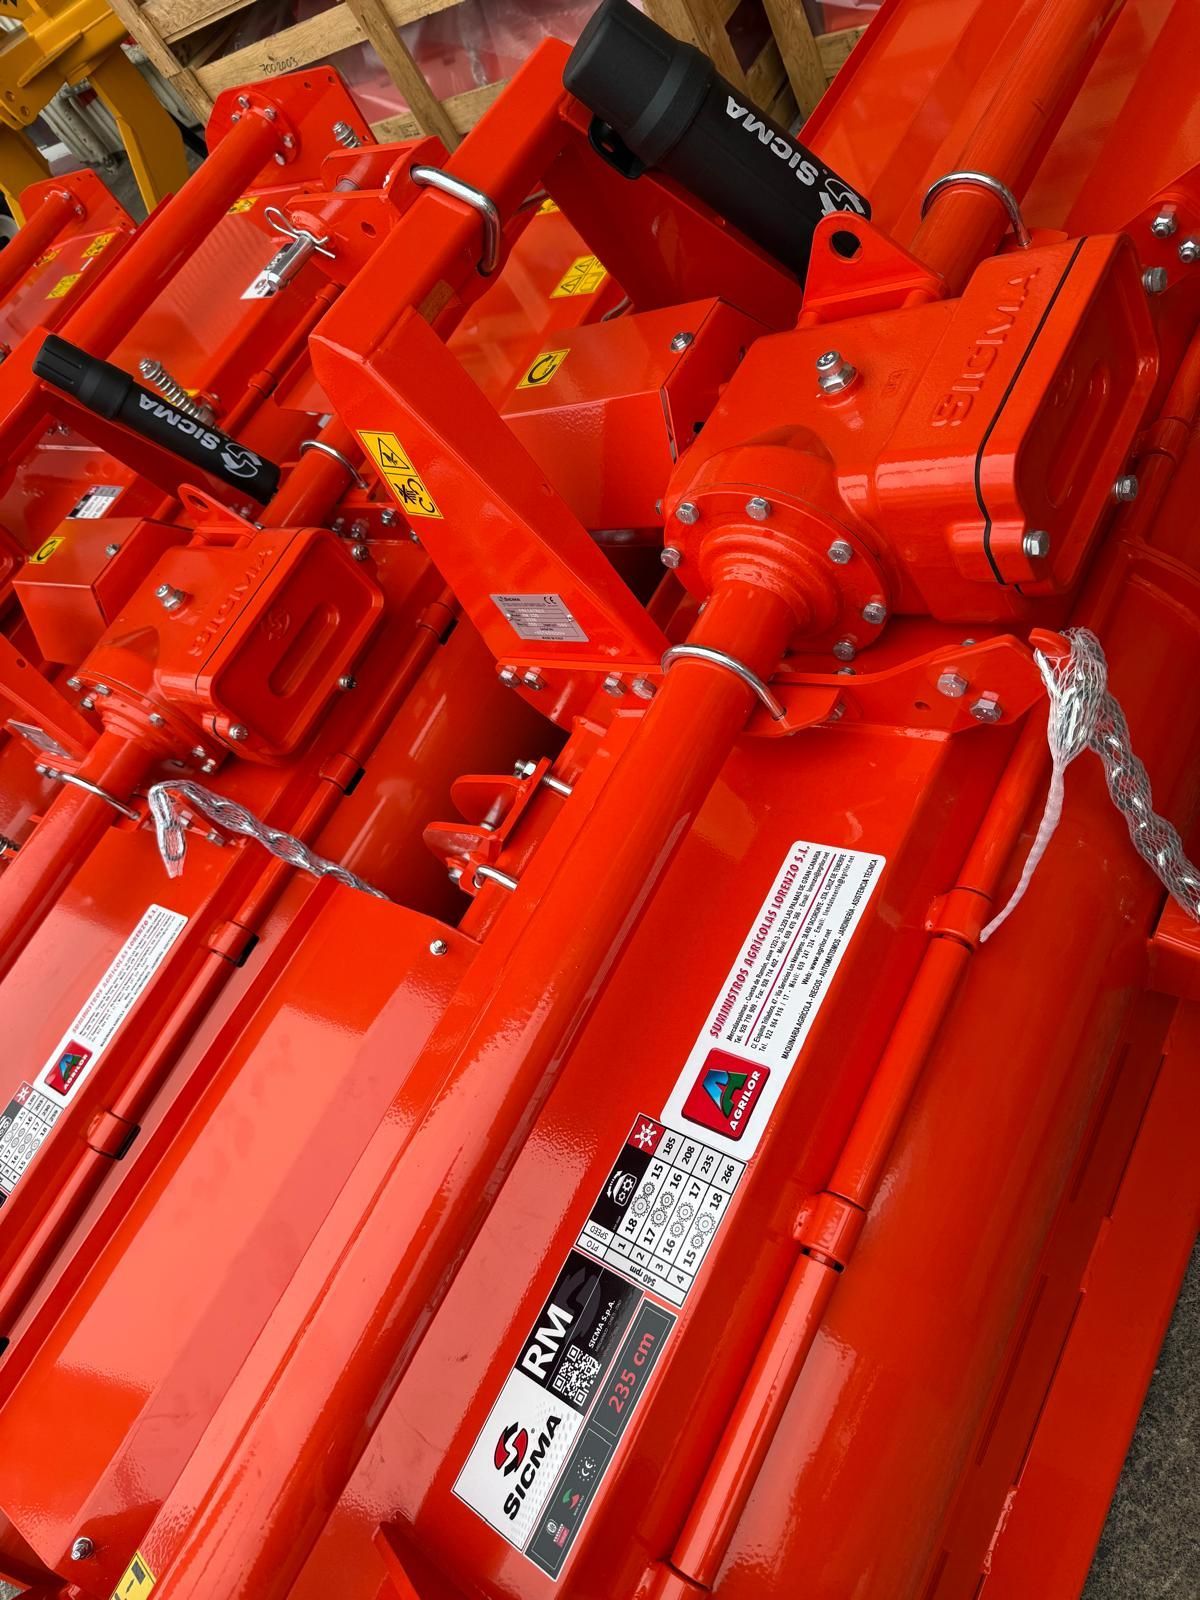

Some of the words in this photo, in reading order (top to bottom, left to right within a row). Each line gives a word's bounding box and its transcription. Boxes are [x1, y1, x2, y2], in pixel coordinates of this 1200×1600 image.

[726, 95, 819, 186] SICMA
[930, 267, 1042, 427] SICMA
[139, 393, 220, 450] SICMA
[800, 869, 812, 884] GRAN
[807, 850, 822, 870] CANARIA
[788, 890, 802, 909] PALMAS
[796, 883, 805, 891] DE
[783, 908, 793, 919] LAS
[709, 968, 748, 1038] SUMINISTROS
[743, 909, 777, 967] AGRÍCOLAS
[771, 863, 799, 909] LORENZO
[793, 845, 810, 863] S.L.
[752, 1024, 766, 1043] Esquina
[777, 970, 791, 989] Servicios
[786, 962, 795, 971] Los
[824, 878, 834, 890] CRUZ
[832, 853, 846, 872] TENERIFE
[780, 1026, 801, 1059] MAQUINARIA
[795, 1000, 813, 1027] AGRÍCOLA
[808, 978, 823, 998] RIEGOS
[818, 938, 841, 977] AUTOMATISMOS
[837, 908, 855, 936] JARDINERÍA
[851, 878, 869, 906] ASISTENCIA
[862, 858, 878, 878] TÉCNICA
[800, 970, 812, 985] Web:
[809, 928, 832, 970] www.agrilor.net
[733, 1034, 743, 1044] Tel.
[798, 893, 810, 907] Email:
[744, 984, 757, 1001] Cuesta
[752, 977, 760, 985] de
[758, 1042, 768, 1052] Tel.
[763, 1028, 773, 1039] 922
[800, 949, 810, 959] 247
[812, 917, 825, 933] Email:
[725, 1003, 748, 1041] Mercalaspalmas
[63, 1053, 88, 1090] AGRILOR
[729, 1070, 760, 1130] AGRILOR
[3, 1149, 11, 1158] 17
[24, 1115, 33, 1125] 16
[10, 1155, 18, 1164] 16
[32, 1121, 39, 1131] 17
[17, 1160, 26, 1170] 15
[39, 1126, 47, 1136] 18
[617, 1241, 626, 1250] 1
[624, 1217, 638, 1235] 18
[650, 1163, 663, 1180] 15
[662, 1136, 676, 1155] 185
[635, 1251, 645, 1261] 2
[642, 1227, 655, 1245] 17
[668, 1172, 682, 1189] 16
[681, 1145, 695, 1165] 208
[654, 1262, 664, 1272] 3
[661, 1237, 675, 1256] 16
[687, 1182, 701, 1199] 17
[699, 1154, 714, 1174] 235
[585, 1239, 599, 1252] PTO
[589, 1224, 608, 1240] SPEED
[676, 1274, 684, 1284] 4
[682, 1249, 696, 1267] 15
[708, 1192, 723, 1210] 18
[720, 1163, 735, 1184] 266
[628, 1261, 646, 1277] rpm
[642, 1273, 656, 1287] 540
[522, 1303, 572, 1378] RM
[587, 1322, 604, 1348] SICMA
[600, 1300, 615, 1322] S.p.A.
[608, 1368, 636, 1413] 235
[633, 1332, 654, 1366] cm
[503, 1415, 561, 1519] SICMA
